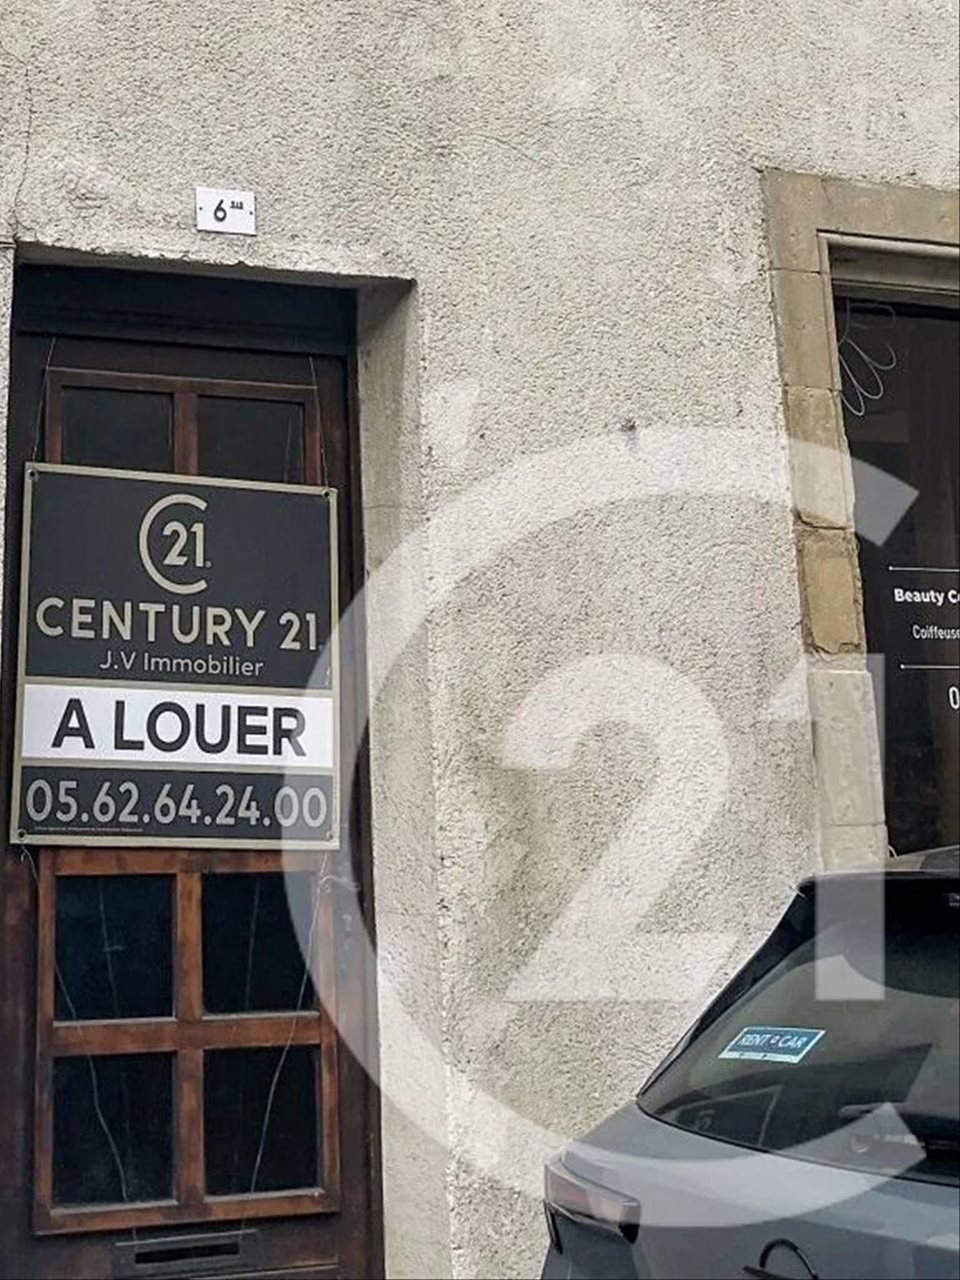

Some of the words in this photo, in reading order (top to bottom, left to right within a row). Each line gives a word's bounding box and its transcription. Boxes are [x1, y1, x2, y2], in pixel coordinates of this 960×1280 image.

[214, 199, 227, 222] 6
[894, 588, 945, 606] Beauty
[36, 597, 266, 648] CENTURY
[279, 612, 318, 651] 21
[100, 651, 136, 671] J.V
[143, 652, 264, 677] Immobilier
[51, 698, 95, 749] A
[114, 700, 307, 757] LOUER
[26, 779, 328, 827] 05.62.64.24.00
